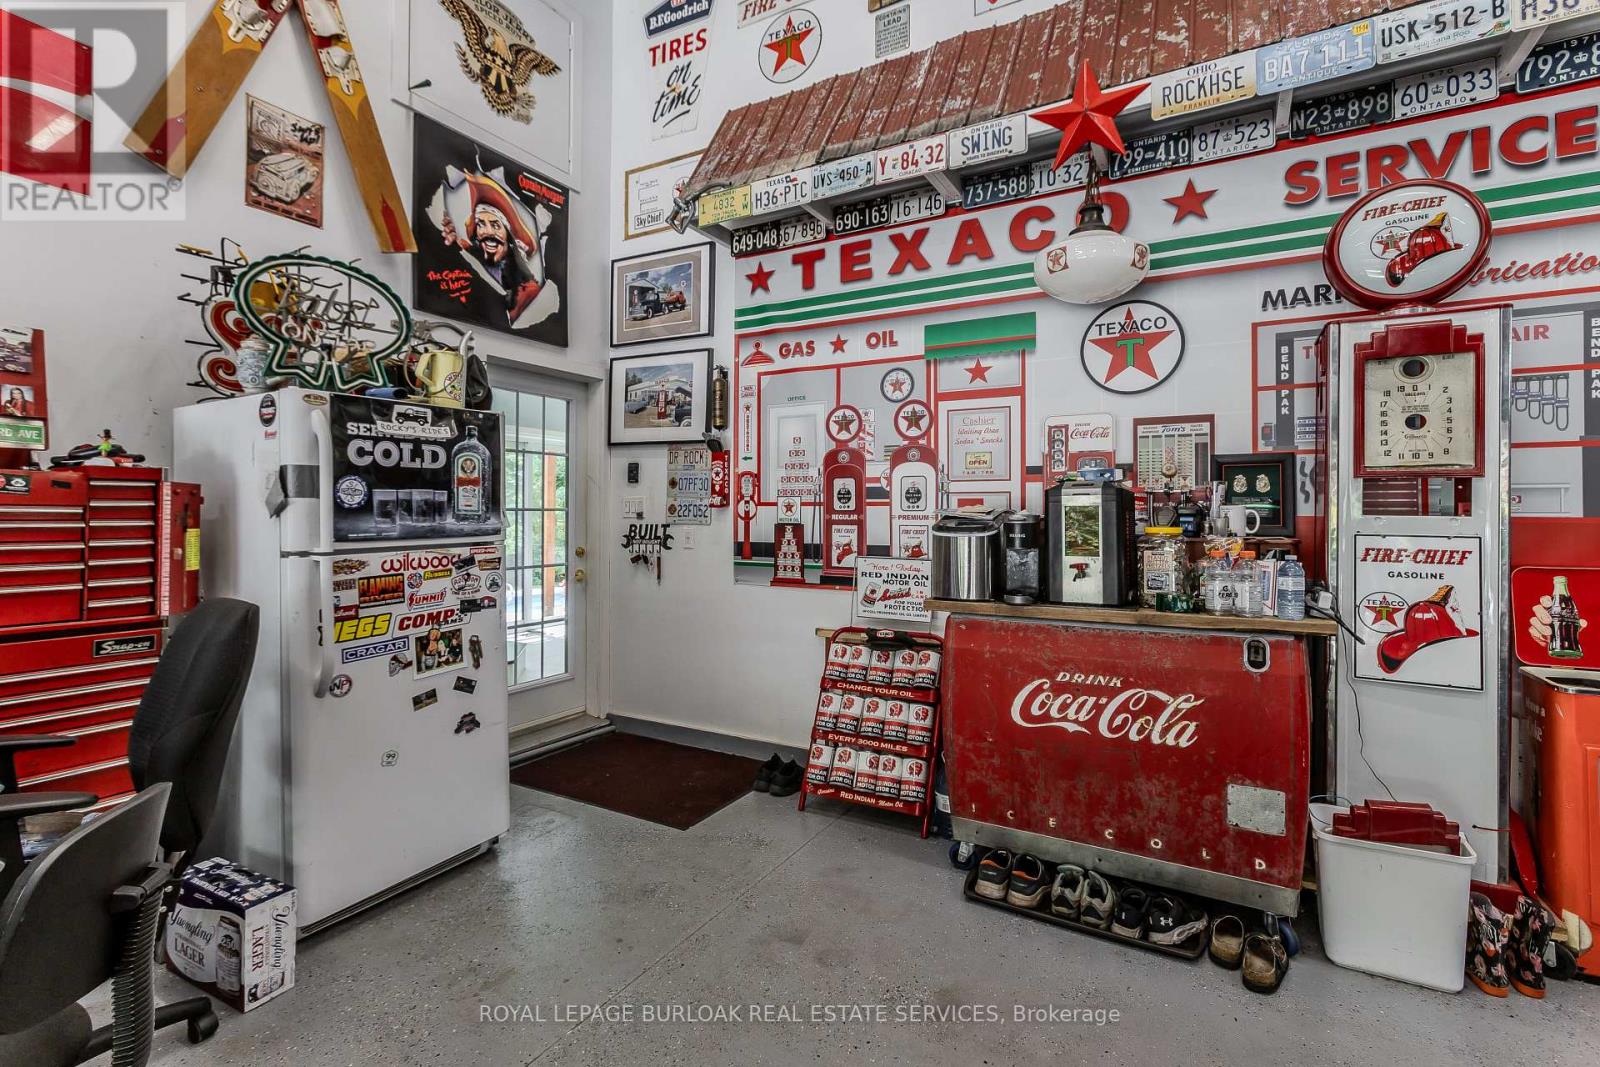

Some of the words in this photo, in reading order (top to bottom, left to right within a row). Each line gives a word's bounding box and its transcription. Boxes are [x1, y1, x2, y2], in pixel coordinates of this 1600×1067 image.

[768, 20, 812, 42] TEXACO
[883, 16, 902, 28] LEAD
[1381, 0, 1505, 48] USK-512-B
[649, 28, 707, 67] TIRES
[1563, 34, 1597, 49] 1971
[1264, 49, 1309, 82] BA7
[1321, 36, 1368, 68] 111
[1524, 49, 1571, 82] 792
[667, 61, 692, 87] on
[1187, 63, 1217, 76] OHIO
[1162, 66, 1245, 108] ROCKHSE
[1446, 68, 1493, 97] 033
[1184, 97, 1221, 111] FRANKLIN
[1293, 104, 1331, 132] N23
[1348, 92, 1389, 119] 898
[1410, 96, 1467, 114] ONTARIO
[971, 121, 1002, 134] ONTARIO
[1235, 118, 1271, 144] 523
[1315, 119, 1366, 133] ONTARIO
[961, 126, 1012, 156] SWING
[1133, 135, 1166, 148] ONTARIO
[1205, 143, 1250, 158] ONTARIO
[1284, 105, 1600, 205] SERVICE
[766, 176, 785, 188] TEXAS
[813, 161, 872, 190] UVS-450-A
[713, 197, 735, 210] 4832
[1362, 195, 1447, 222] FIRE-CHIEF
[636, 216, 646, 227] Sky
[647, 213, 662, 224] Chief
[1385, 213, 1430, 226] GASOLINE
[1094, 317, 1167, 337] TEXACO
[779, 341, 815, 359] GAS
[866, 330, 898, 348] OIL
[1281, 345, 1289, 380] BEND
[1281, 389, 1289, 415] PAK
[380, 422, 417, 433] ROCKY'S
[962, 416, 996, 426] Cashier
[1161, 425, 1185, 433] Tom's
[18, 428, 40, 439] AVE
[1070, 426, 1110, 439] Coca-Cola
[347, 438, 447, 469] COLD
[669, 451, 679, 464] DR
[683, 450, 704, 465] ROCK
[678, 477, 709, 491] 07PF30
[629, 524, 670, 540] BUILT
[1360, 548, 1472, 566] FIRE-CHIEF
[887, 573, 929, 581] INDIAN
[896, 563, 923, 573] Today
[1387, 571, 1445, 580] GASOLINE
[360, 575, 404, 595] FLAMING
[408, 588, 447, 609] SUMMIT
[1366, 599, 1405, 608] TEXACO
[398, 609, 456, 631] COMP
[99, 640, 151, 655] Snap-on
[345, 641, 405, 660] CRAGAR
[1056, 672, 1123, 688] DRINK
[837, 682, 873, 692] CHANGE
[875, 687, 898, 696] YOUR
[900, 690, 915, 698] OIL
[1011, 678, 1205, 749] Coca-Cola
[828, 733, 856, 743] EVERY
[857, 737, 879, 747] 3000
[880, 743, 908, 752] MILES
[840, 791, 853, 800] RED
[854, 795, 875, 804] INDIAN
[170, 908, 216, 945] Yuengling
[271, 905, 291, 970] Yuengling
[174, 937, 205, 967] LAGER
[251, 925, 265, 972] LAGER
